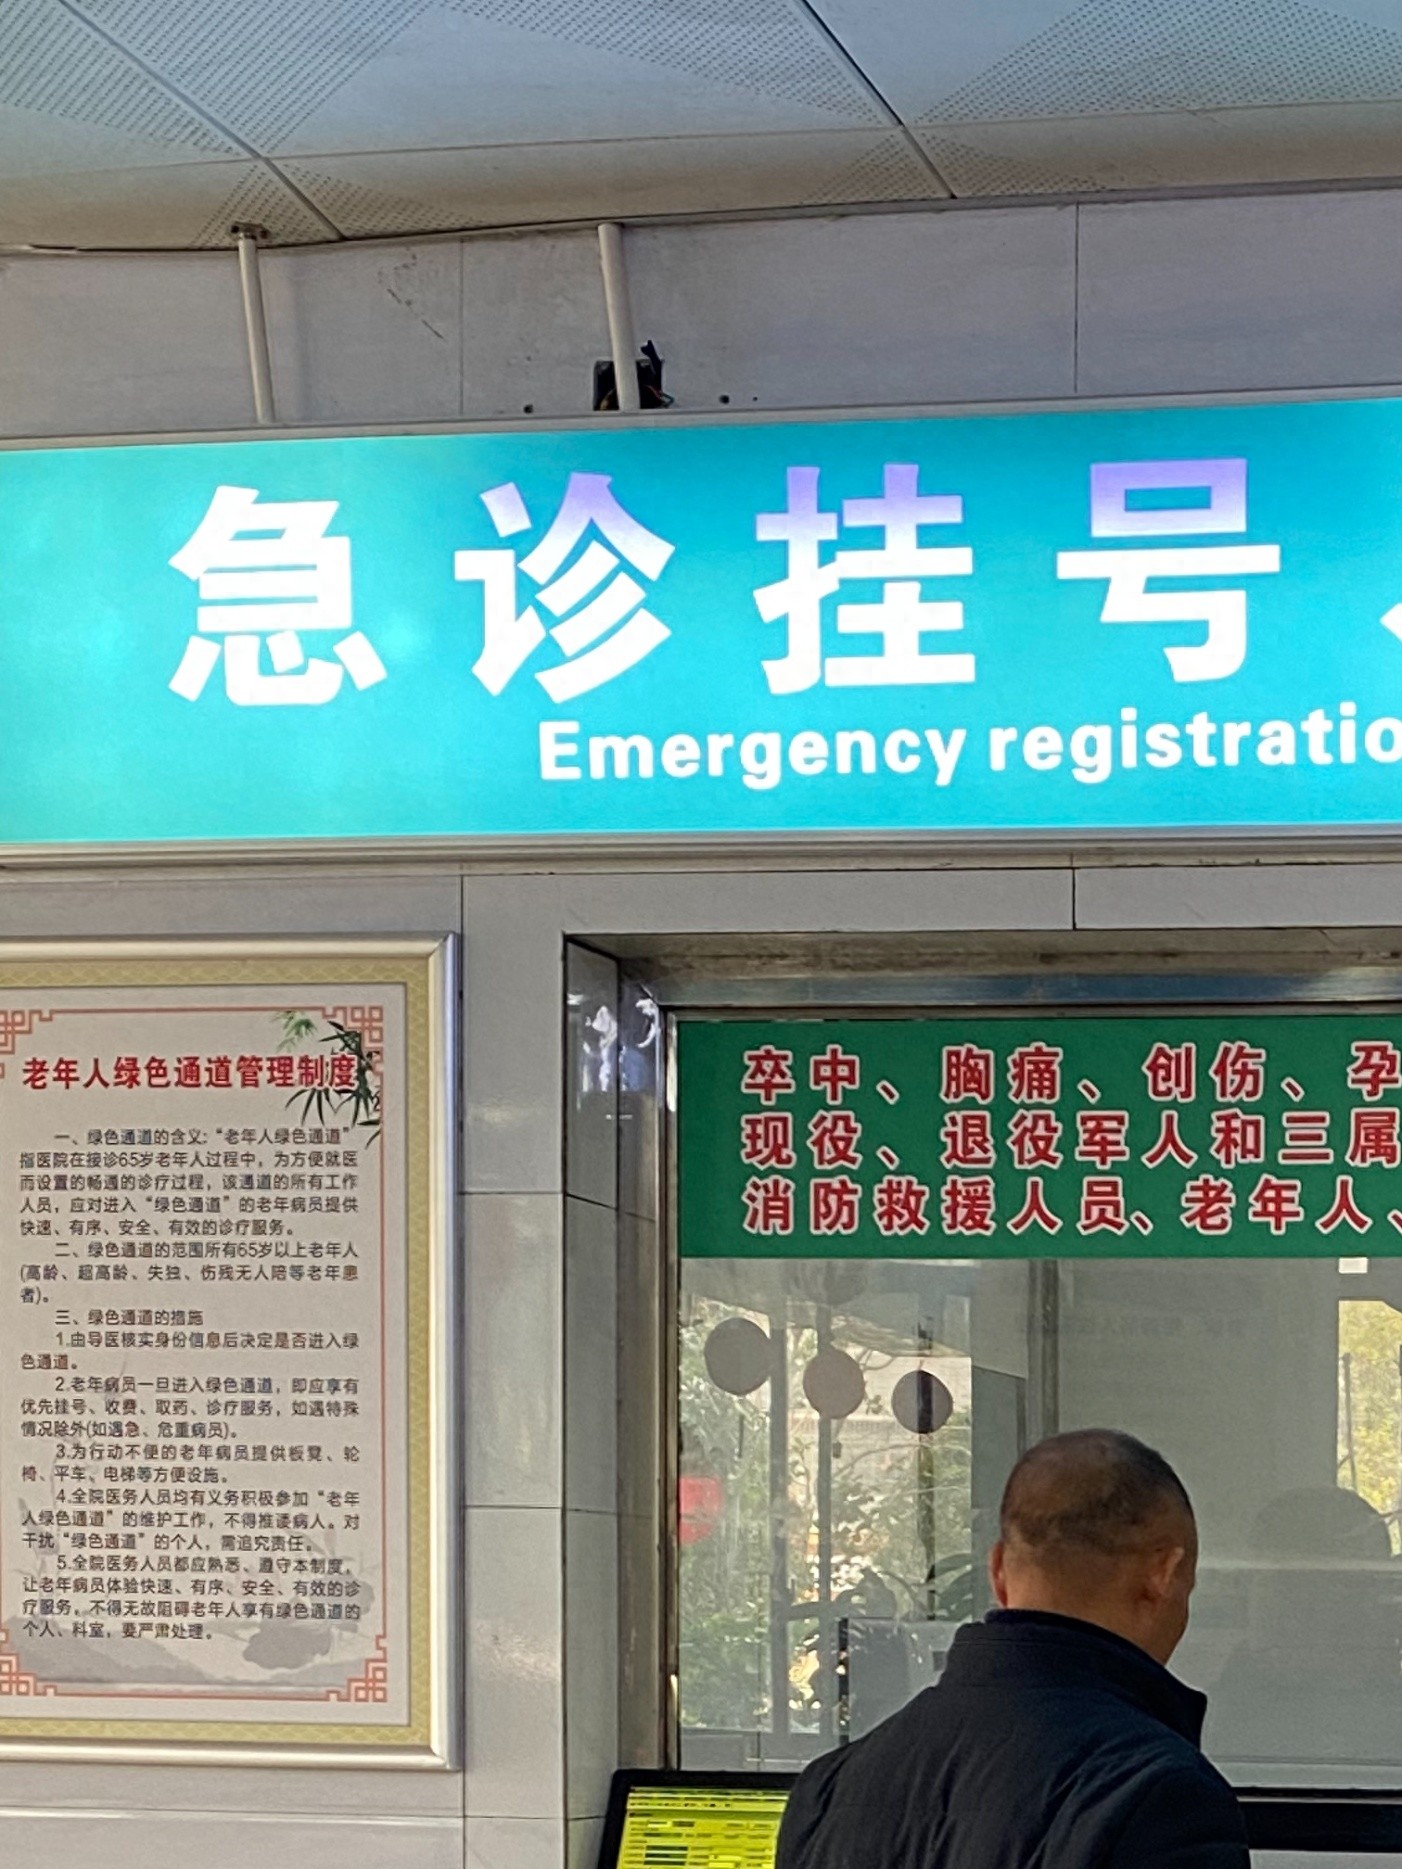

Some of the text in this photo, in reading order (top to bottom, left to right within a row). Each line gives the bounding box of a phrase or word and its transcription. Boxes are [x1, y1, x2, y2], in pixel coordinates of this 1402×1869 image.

[539, 717, 959, 789] Emergency
[22, 1054, 356, 1090] 老年人绿色通道管理制度
[55, 1309, 204, 1326] 三、绿色通道的措施
[21, 1353, 78, 1370] 色通道。
